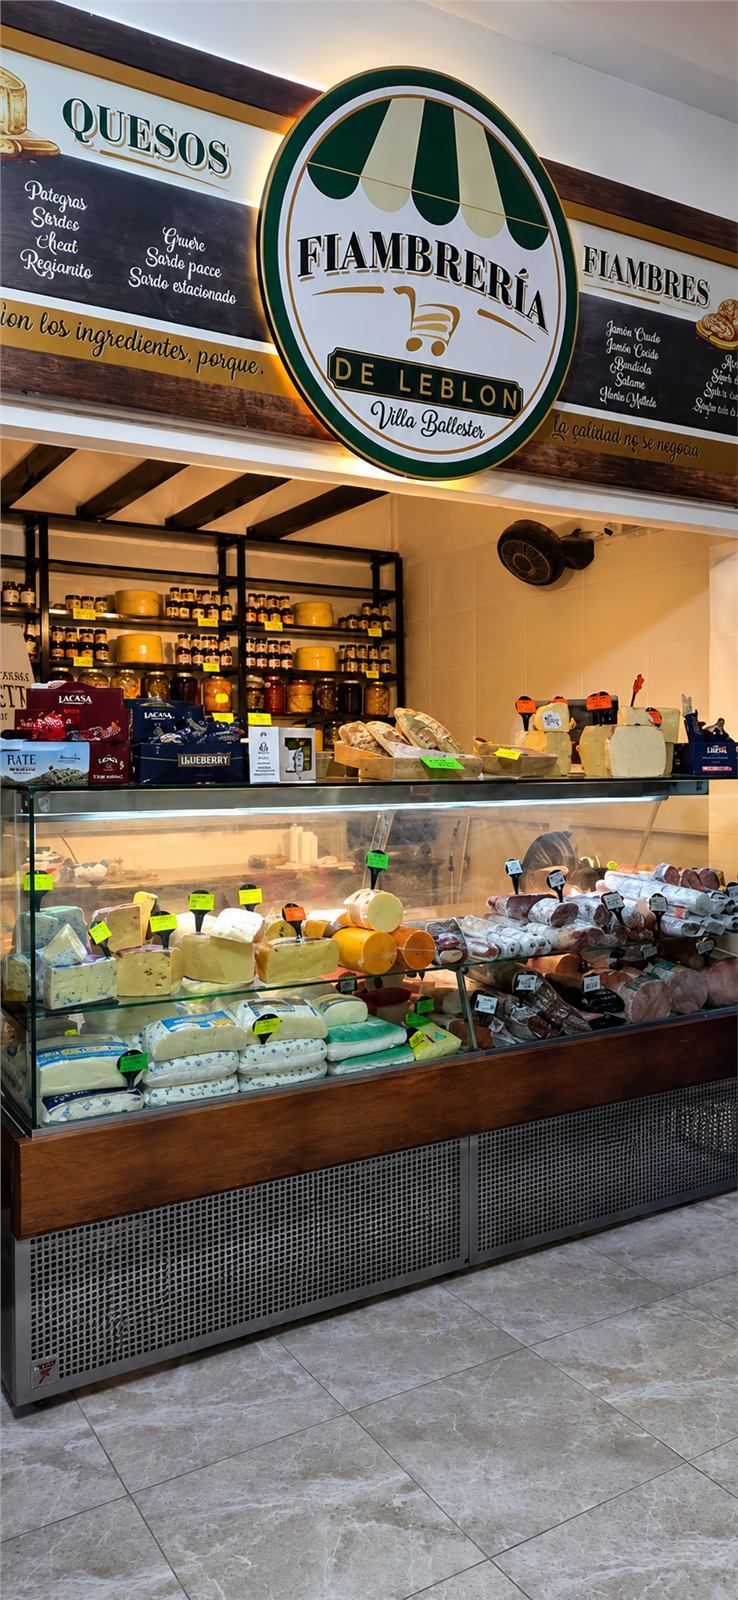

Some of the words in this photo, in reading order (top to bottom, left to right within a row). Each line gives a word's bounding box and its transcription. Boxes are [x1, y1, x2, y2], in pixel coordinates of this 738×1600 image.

[62, 97, 231, 175] QUESOS
[24, 180, 88, 213] Pategras
[145, 246, 186, 268] Sardo
[162, 226, 207, 253] Gruere
[20, 248, 94, 280] Regianito
[582, 245, 710, 308] FIAMBRES
[128, 266, 170, 288] Sardo
[172, 280, 238, 305] estacionado
[297, 230, 549, 336] FIAMBRERÍA
[40, 311, 71, 338] los
[75, 321, 192, 364] ingredientes,
[335, 357, 375, 386] DE
[399, 367, 518, 411] LEBLON
[370, 400, 417, 430] Villa
[421, 409, 485, 440] Ballester
[657, 440, 700, 463] negocia
[58, 695, 93, 705] LACASA
[7, 754, 36, 766] RATE
